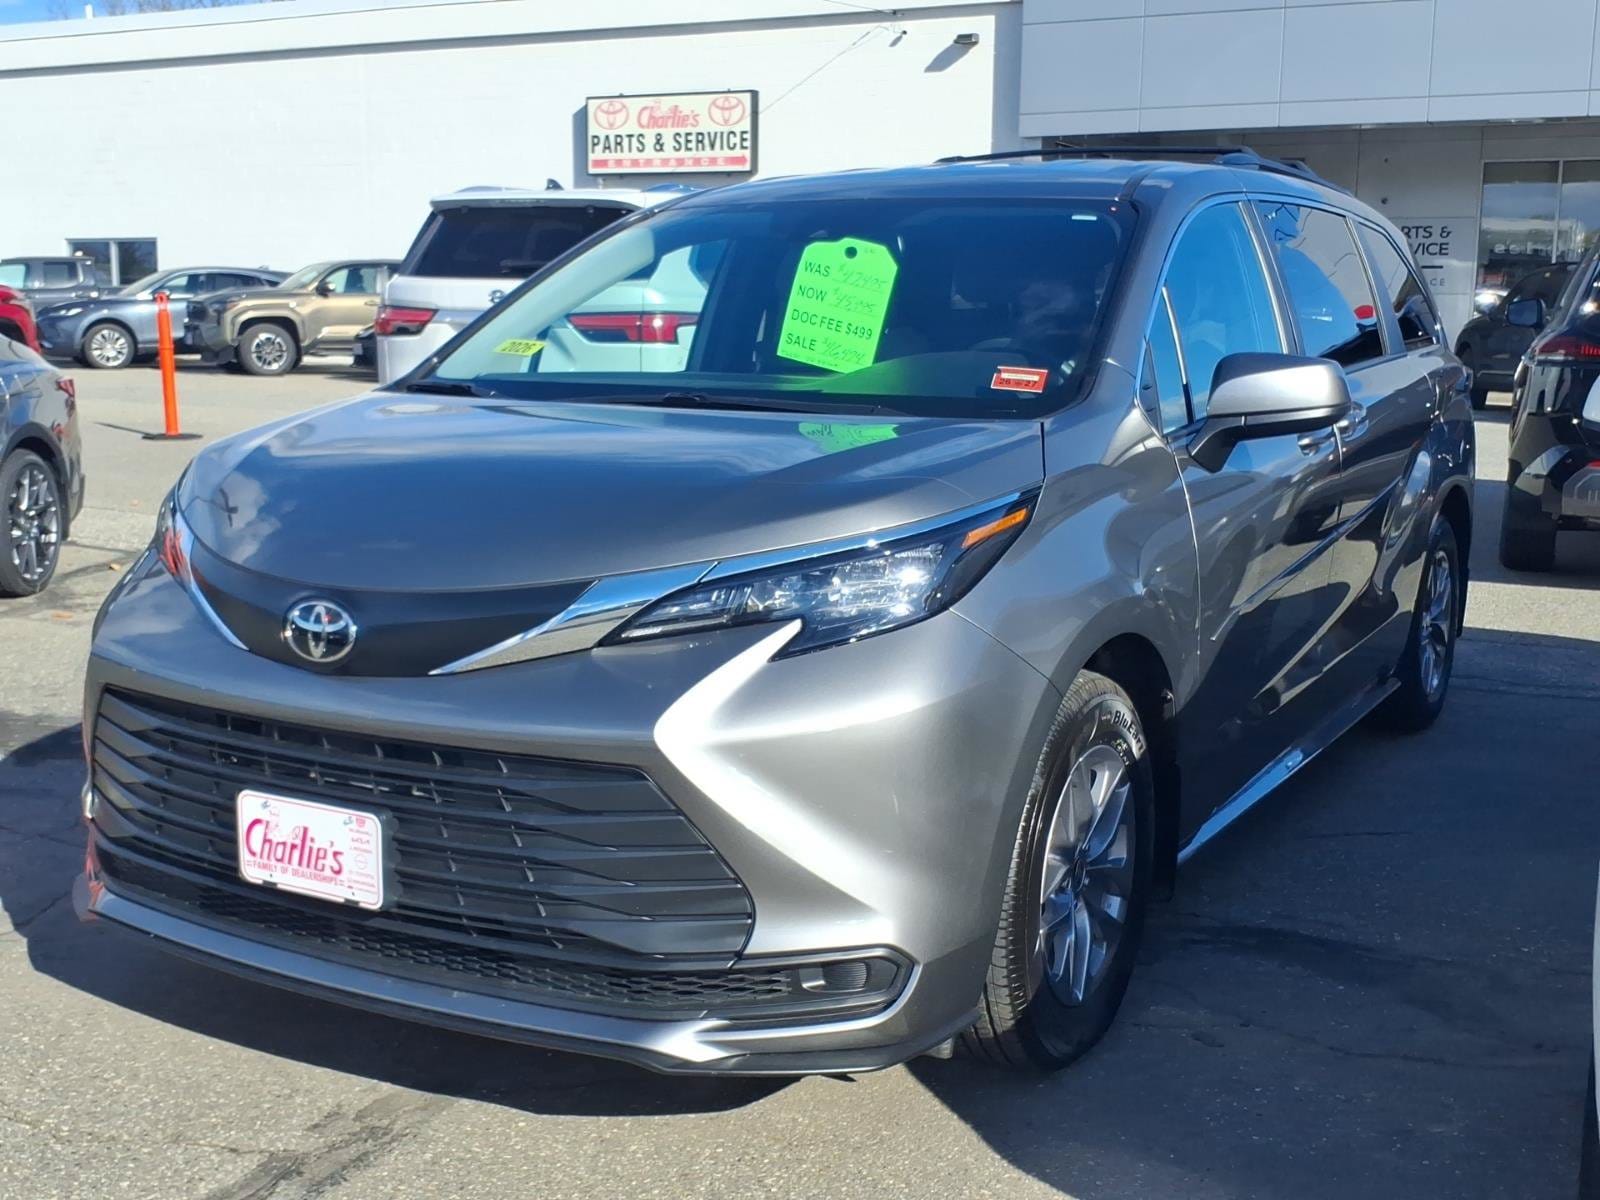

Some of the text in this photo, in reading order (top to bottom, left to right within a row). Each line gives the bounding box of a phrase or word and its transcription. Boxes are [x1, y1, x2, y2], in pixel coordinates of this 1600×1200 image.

[637, 104, 700, 129] Charlie's
[591, 130, 749, 154] PARTS & SERVICE
[1440, 225, 1452, 239] &
[804, 260, 831, 277] WAS
[797, 285, 827, 302] NOW
[791, 308, 873, 340] DOC FEE $499
[785, 332, 817, 351] SALE
[245, 817, 344, 875] Charlie's
